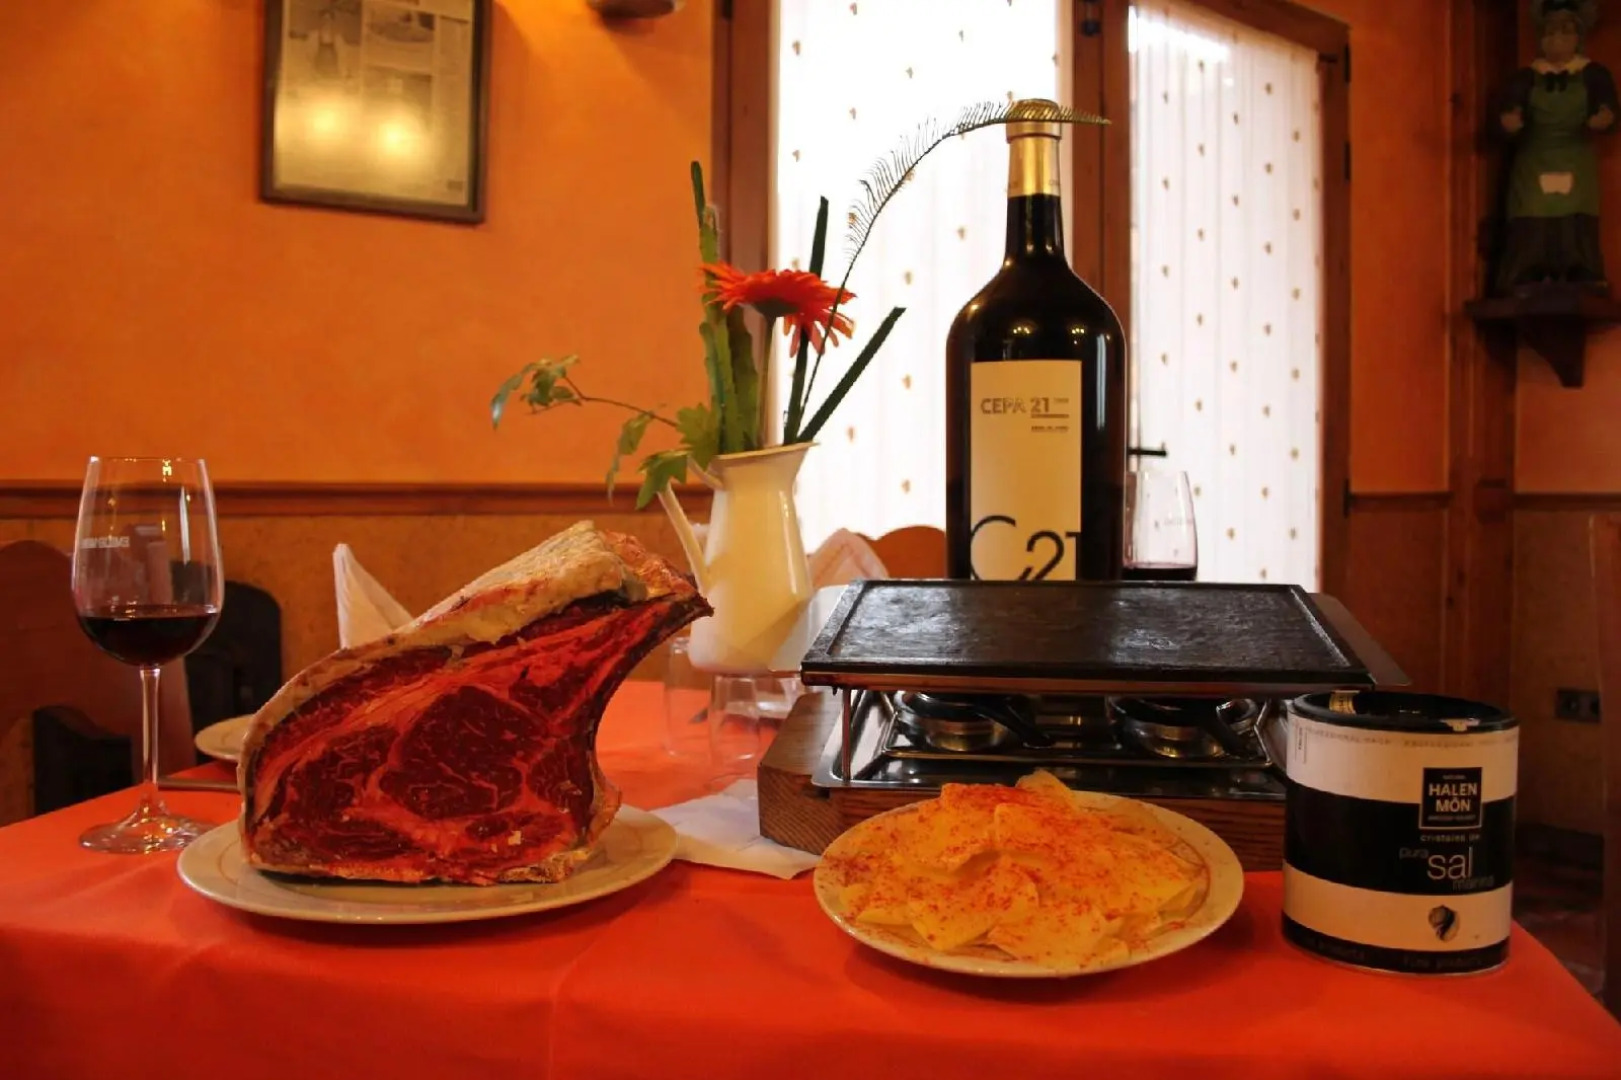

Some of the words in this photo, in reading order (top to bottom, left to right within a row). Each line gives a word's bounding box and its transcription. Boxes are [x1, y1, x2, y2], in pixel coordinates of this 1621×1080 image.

[980, 397, 1027, 414] CEPA
[1030, 397, 1050, 413] 21
[1428, 781, 1478, 796] HALEN
[1435, 796, 1471, 812] MÔN
[1426, 846, 1474, 880] sal
